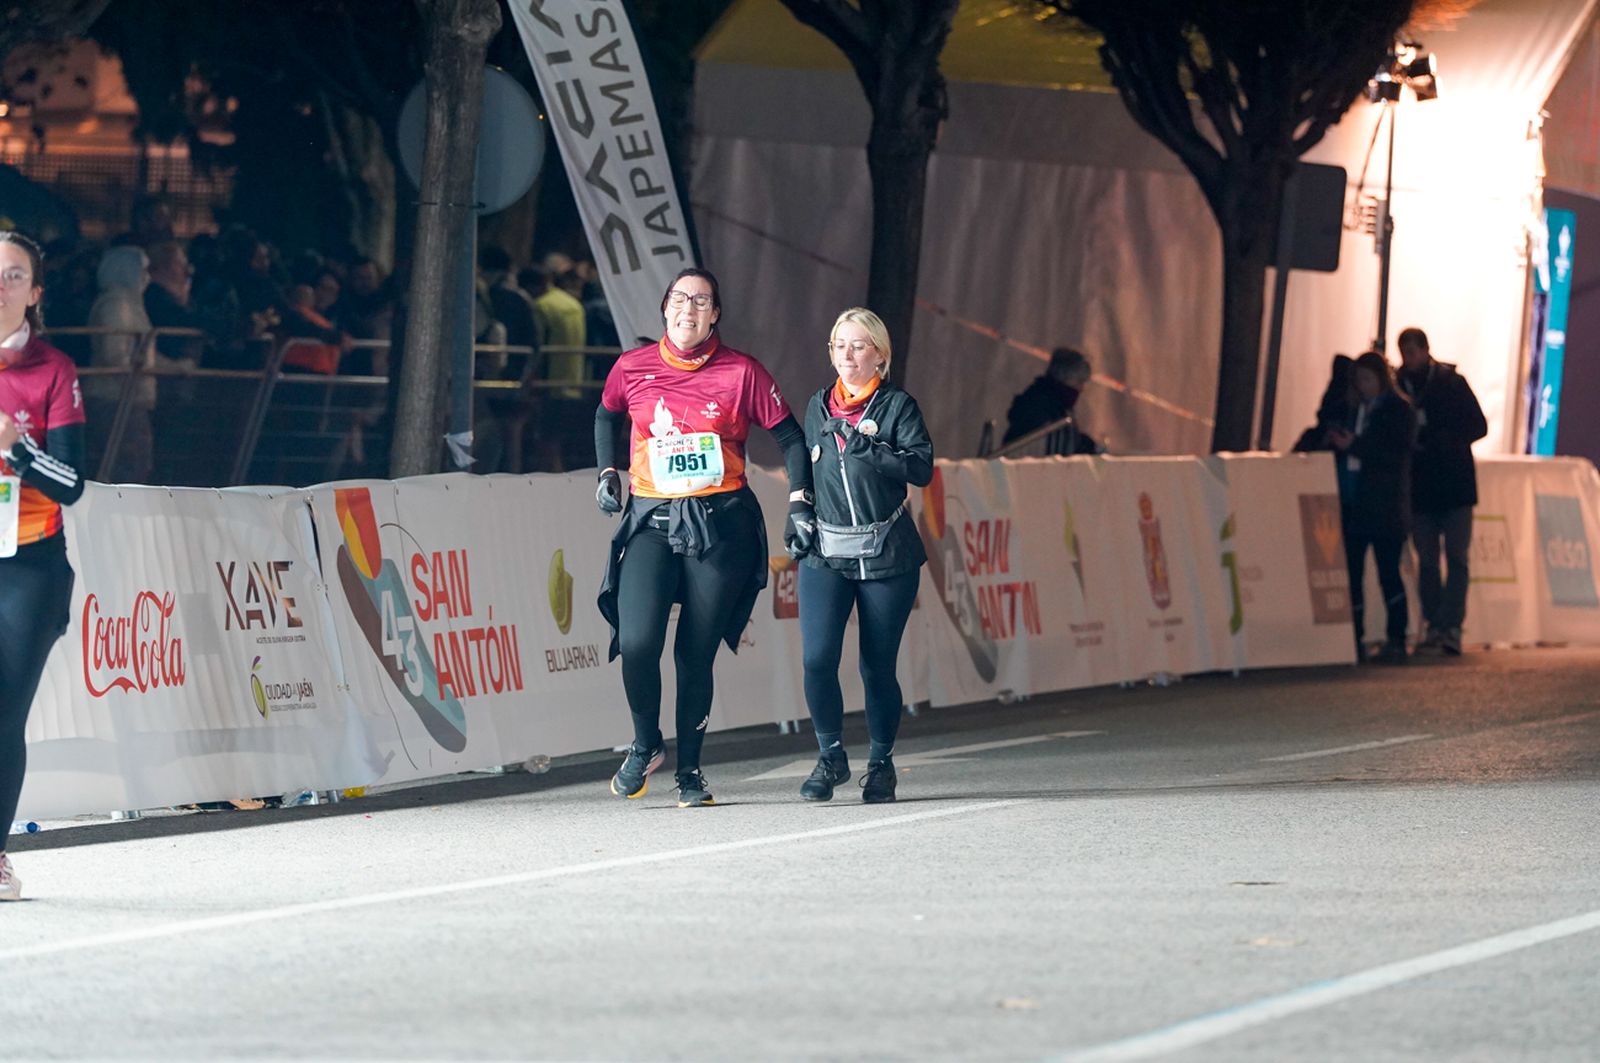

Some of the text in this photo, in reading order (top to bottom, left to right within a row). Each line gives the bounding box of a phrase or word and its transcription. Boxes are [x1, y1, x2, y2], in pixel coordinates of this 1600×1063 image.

[575, 0, 685, 262] JAPEMAS
[665, 453, 707, 474] 7951
[963, 518, 1011, 577] SAN
[216, 560, 304, 631] XAVE
[411, 549, 473, 622] SAN
[977, 580, 1042, 640] ANTN
[381, 590, 424, 698] 43
[434, 605, 523, 701] ANTÓN
